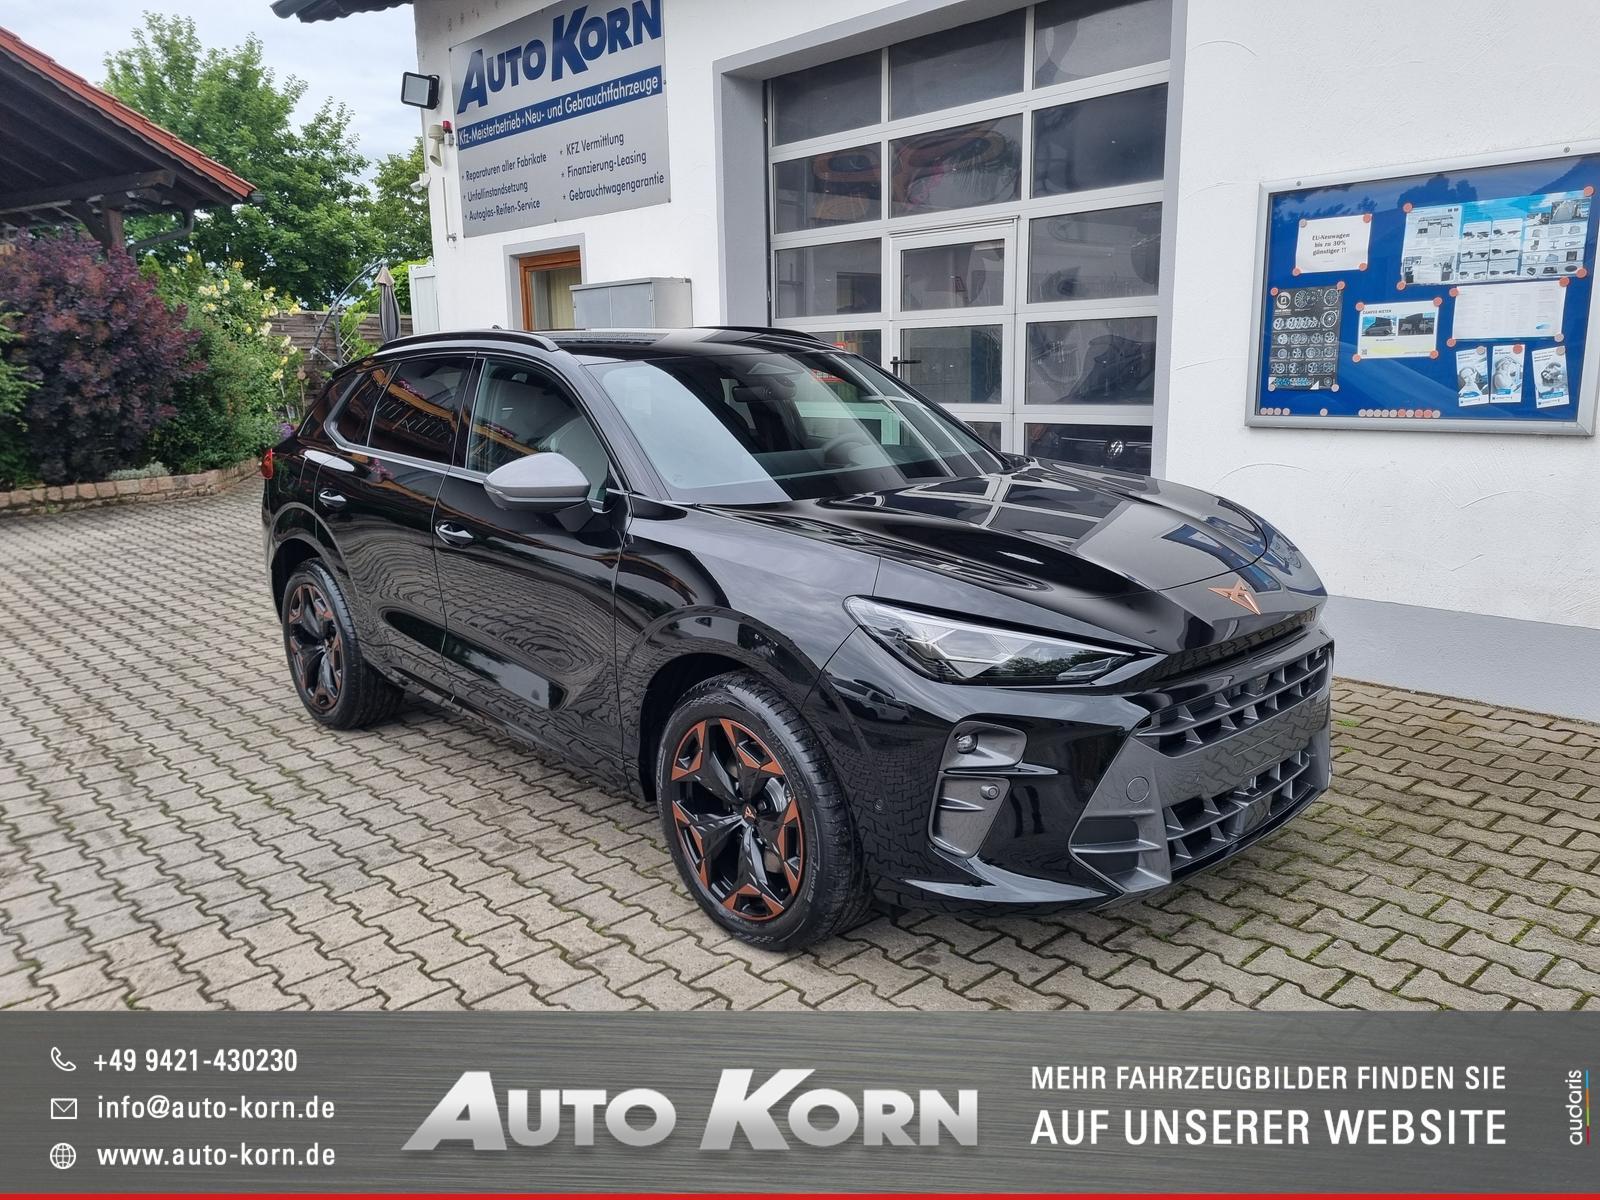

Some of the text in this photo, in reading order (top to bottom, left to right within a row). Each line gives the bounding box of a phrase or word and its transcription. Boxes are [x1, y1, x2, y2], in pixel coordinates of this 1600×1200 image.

[457, 0, 662, 115] AUTO KORN
[547, 100, 563, 119] und
[565, 75, 659, 112] Gebrauchtfahrzeuge
[566, 132, 625, 156] KFZ Vermittlung
[466, 152, 548, 182] Reparaturen aller Fabrikate
[567, 150, 647, 178] Finanzierung-Leasing
[467, 180, 529, 202] Unfallinstandsetzung
[569, 171, 665, 202] Gebrauchtwagengarantie
[469, 198, 541, 221] Autoglas-Reifen-Service
[1312, 248, 1340, 257] günstiger
